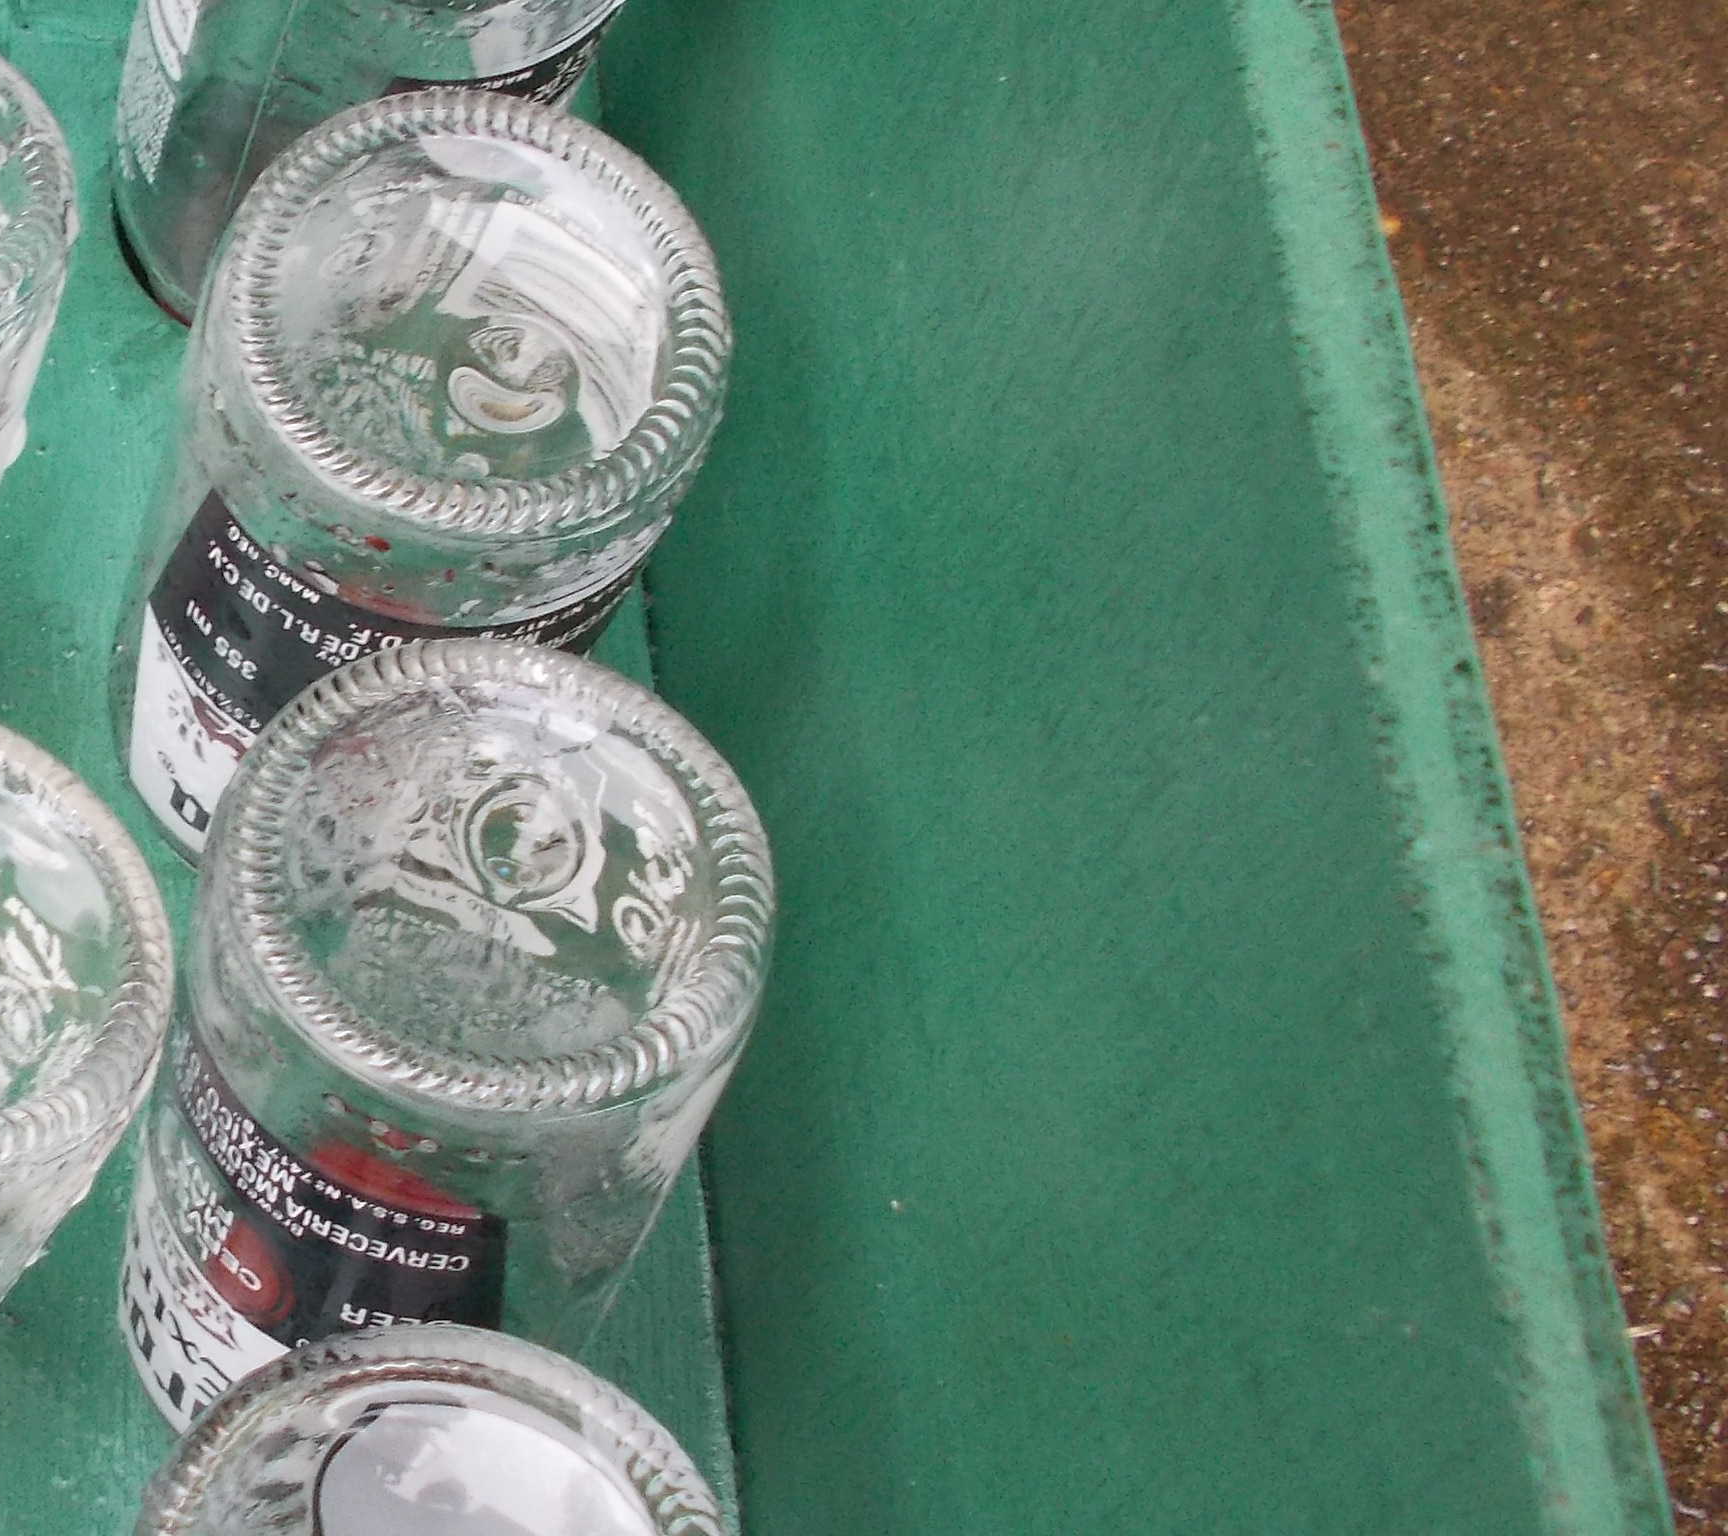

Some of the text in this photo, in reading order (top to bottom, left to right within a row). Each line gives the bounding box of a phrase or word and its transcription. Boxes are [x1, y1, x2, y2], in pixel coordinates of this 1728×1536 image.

[214, 636, 257, 681] 355
[285, 1196, 469, 1271] CERVECERIA
[413, 1218, 465, 1235] REG.
